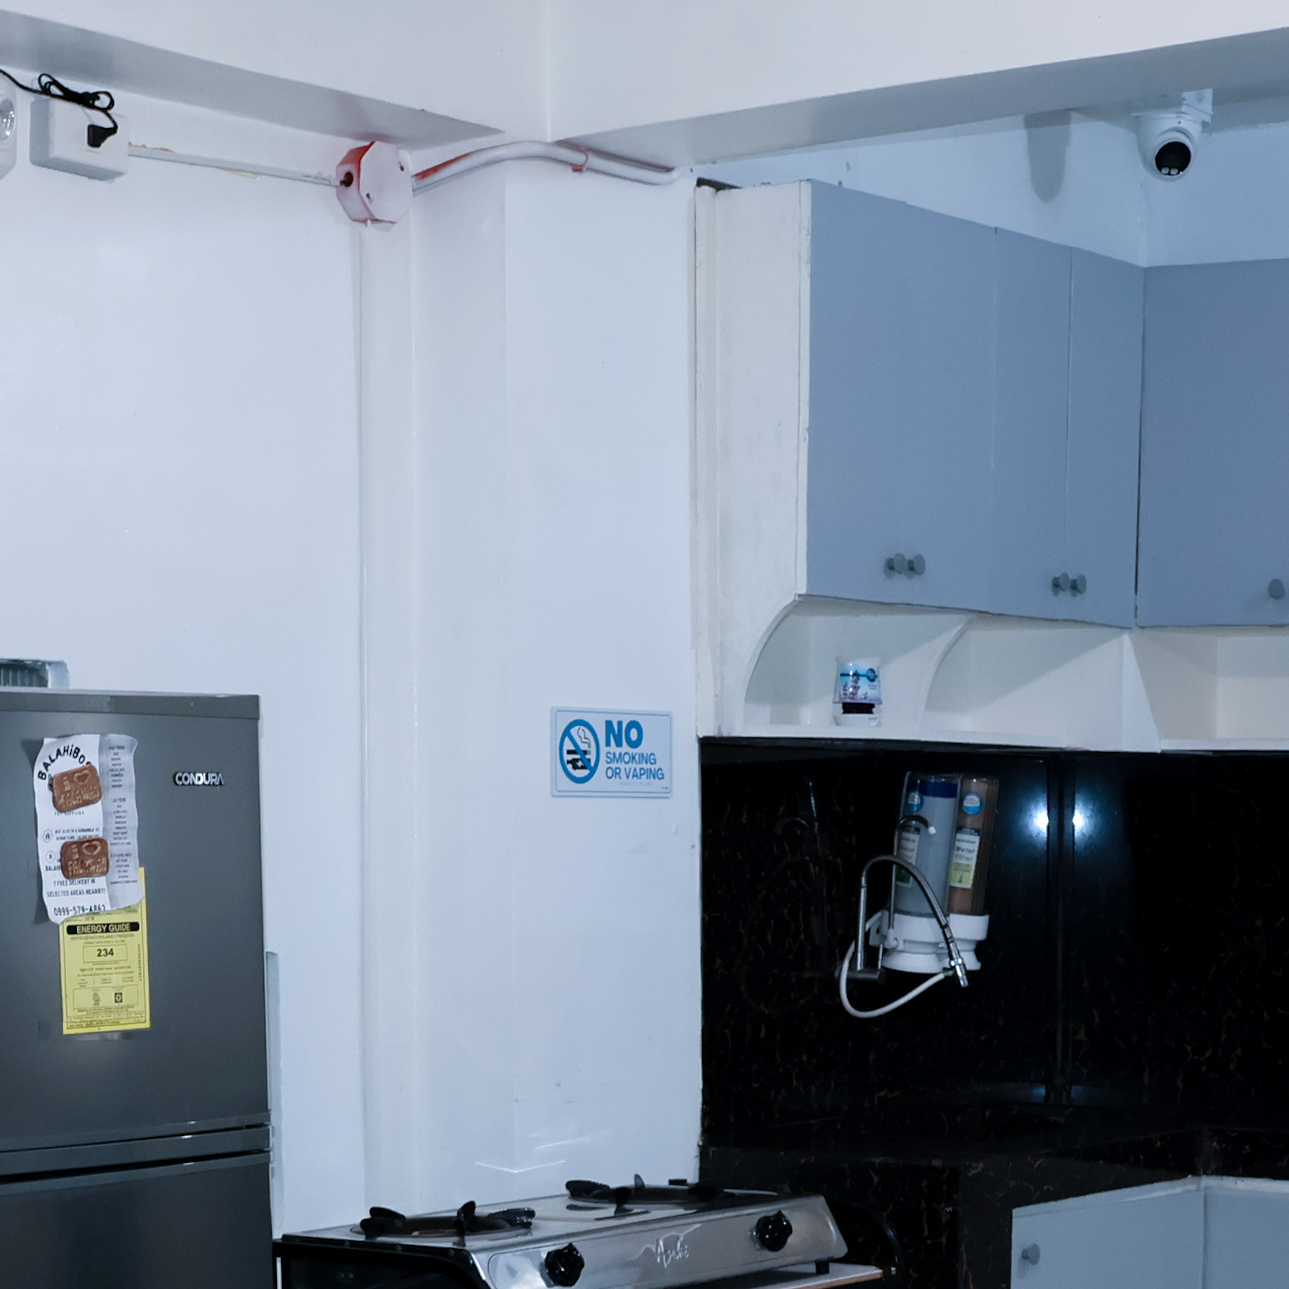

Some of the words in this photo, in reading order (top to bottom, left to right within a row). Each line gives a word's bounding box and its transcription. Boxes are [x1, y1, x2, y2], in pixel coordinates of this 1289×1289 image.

[604, 719, 644, 749] NO
[605, 751, 657, 765] SMOKING
[174, 771, 225, 786] CONDURA
[605, 766, 622, 780] OR
[624, 766, 665, 781] VAPING
[76, 924, 107, 934] ENERGY
[108, 922, 131, 932] GUIDE
[96, 948, 115, 958] 234
